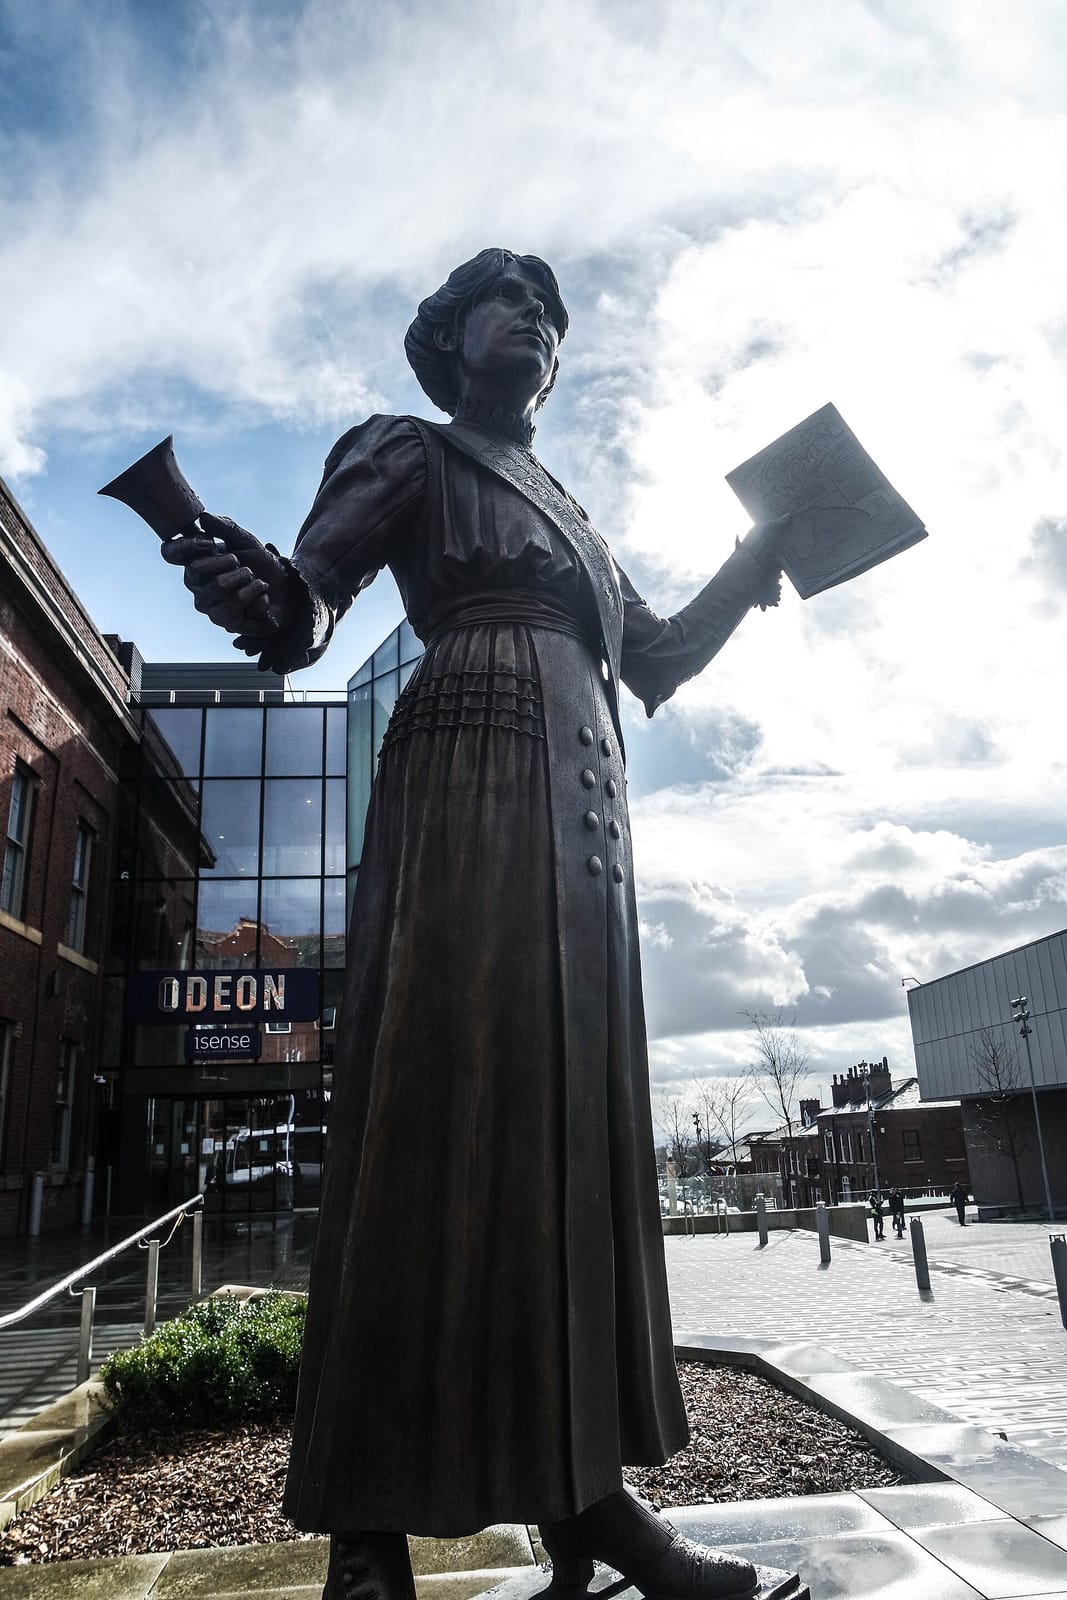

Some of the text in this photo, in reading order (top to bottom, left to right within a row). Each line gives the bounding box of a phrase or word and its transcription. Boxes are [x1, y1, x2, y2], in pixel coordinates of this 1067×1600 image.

[484, 442, 550, 500] VOTES
[158, 974, 286, 1013] ODEON
[194, 1034, 251, 1050] isense
